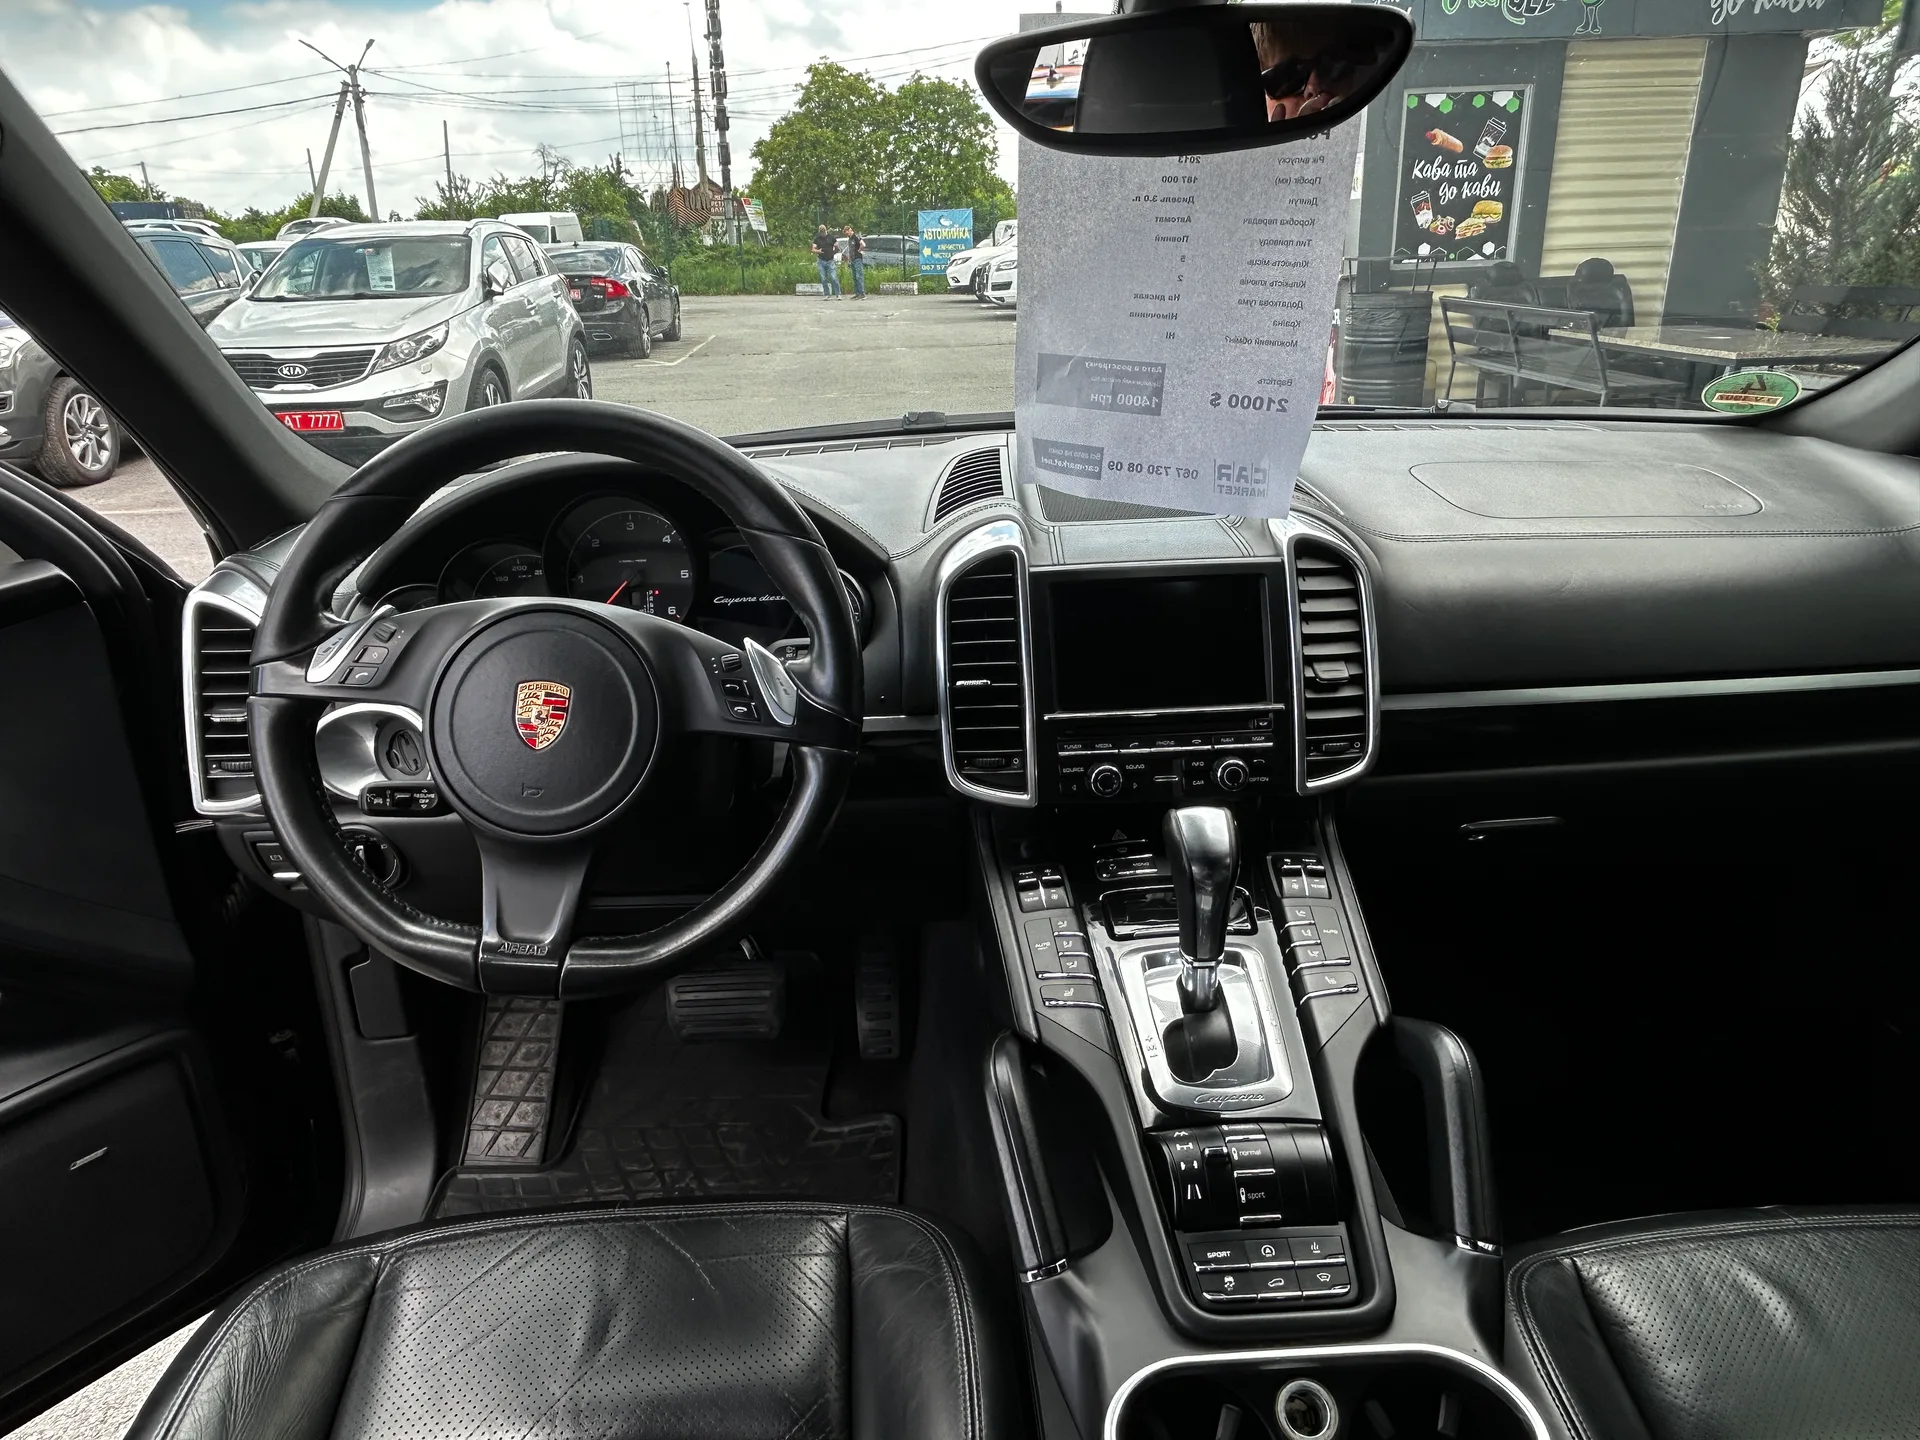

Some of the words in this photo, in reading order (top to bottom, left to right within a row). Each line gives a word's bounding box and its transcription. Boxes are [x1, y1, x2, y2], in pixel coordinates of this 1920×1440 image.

[1412, 156, 1452, 181] Кава
[1454, 160, 1478, 179] та
[1439, 181, 1457, 205] до
[1461, 173, 1502, 199] кави
[923, 224, 970, 240] АВТОМИЙКА
[282, 366, 302, 376] KIA
[308, 414, 338, 428] 7777
[626, 522, 635, 530] 3
[592, 539, 600, 548] 2
[662, 535, 671, 544] 4
[680, 569, 689, 579] 5
[713, 596, 757, 606] Cayenne
[668, 606, 676, 615] 6
[1194, 1093, 1265, 1109] Cayenne
[1248, 1191, 1266, 1200] sport
[1207, 1251, 1231, 1259] SPORT
